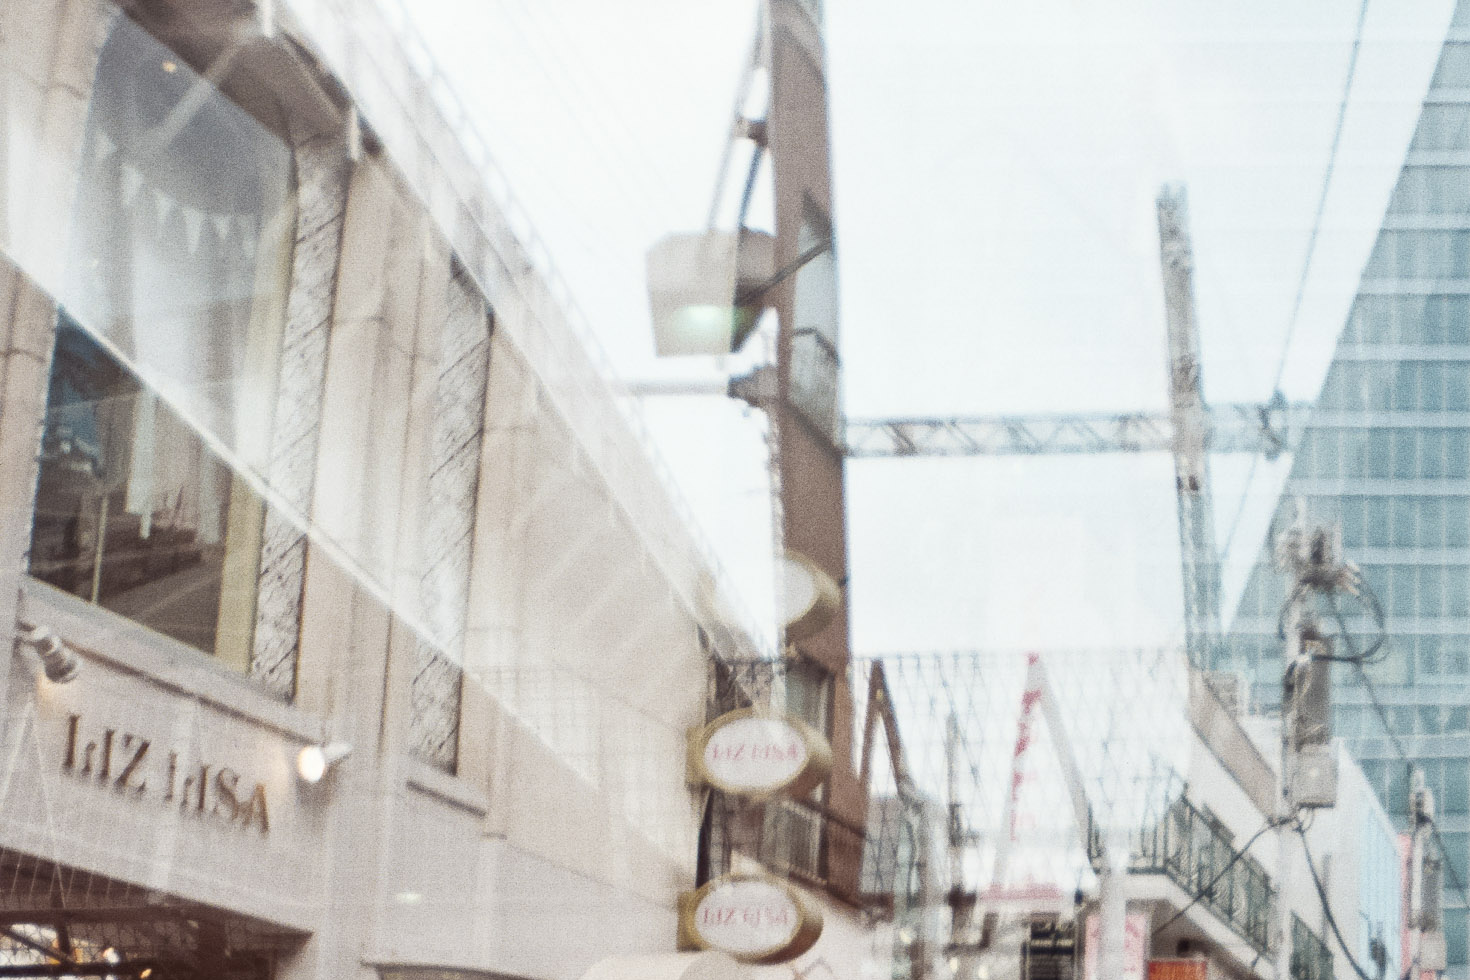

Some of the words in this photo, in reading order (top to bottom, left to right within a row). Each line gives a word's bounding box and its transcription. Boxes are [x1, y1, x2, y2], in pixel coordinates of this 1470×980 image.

[711, 744, 746, 763] LIZ
[62, 713, 151, 797] LIZ
[163, 750, 271, 836] LISA
[702, 906, 736, 926] LIZ
